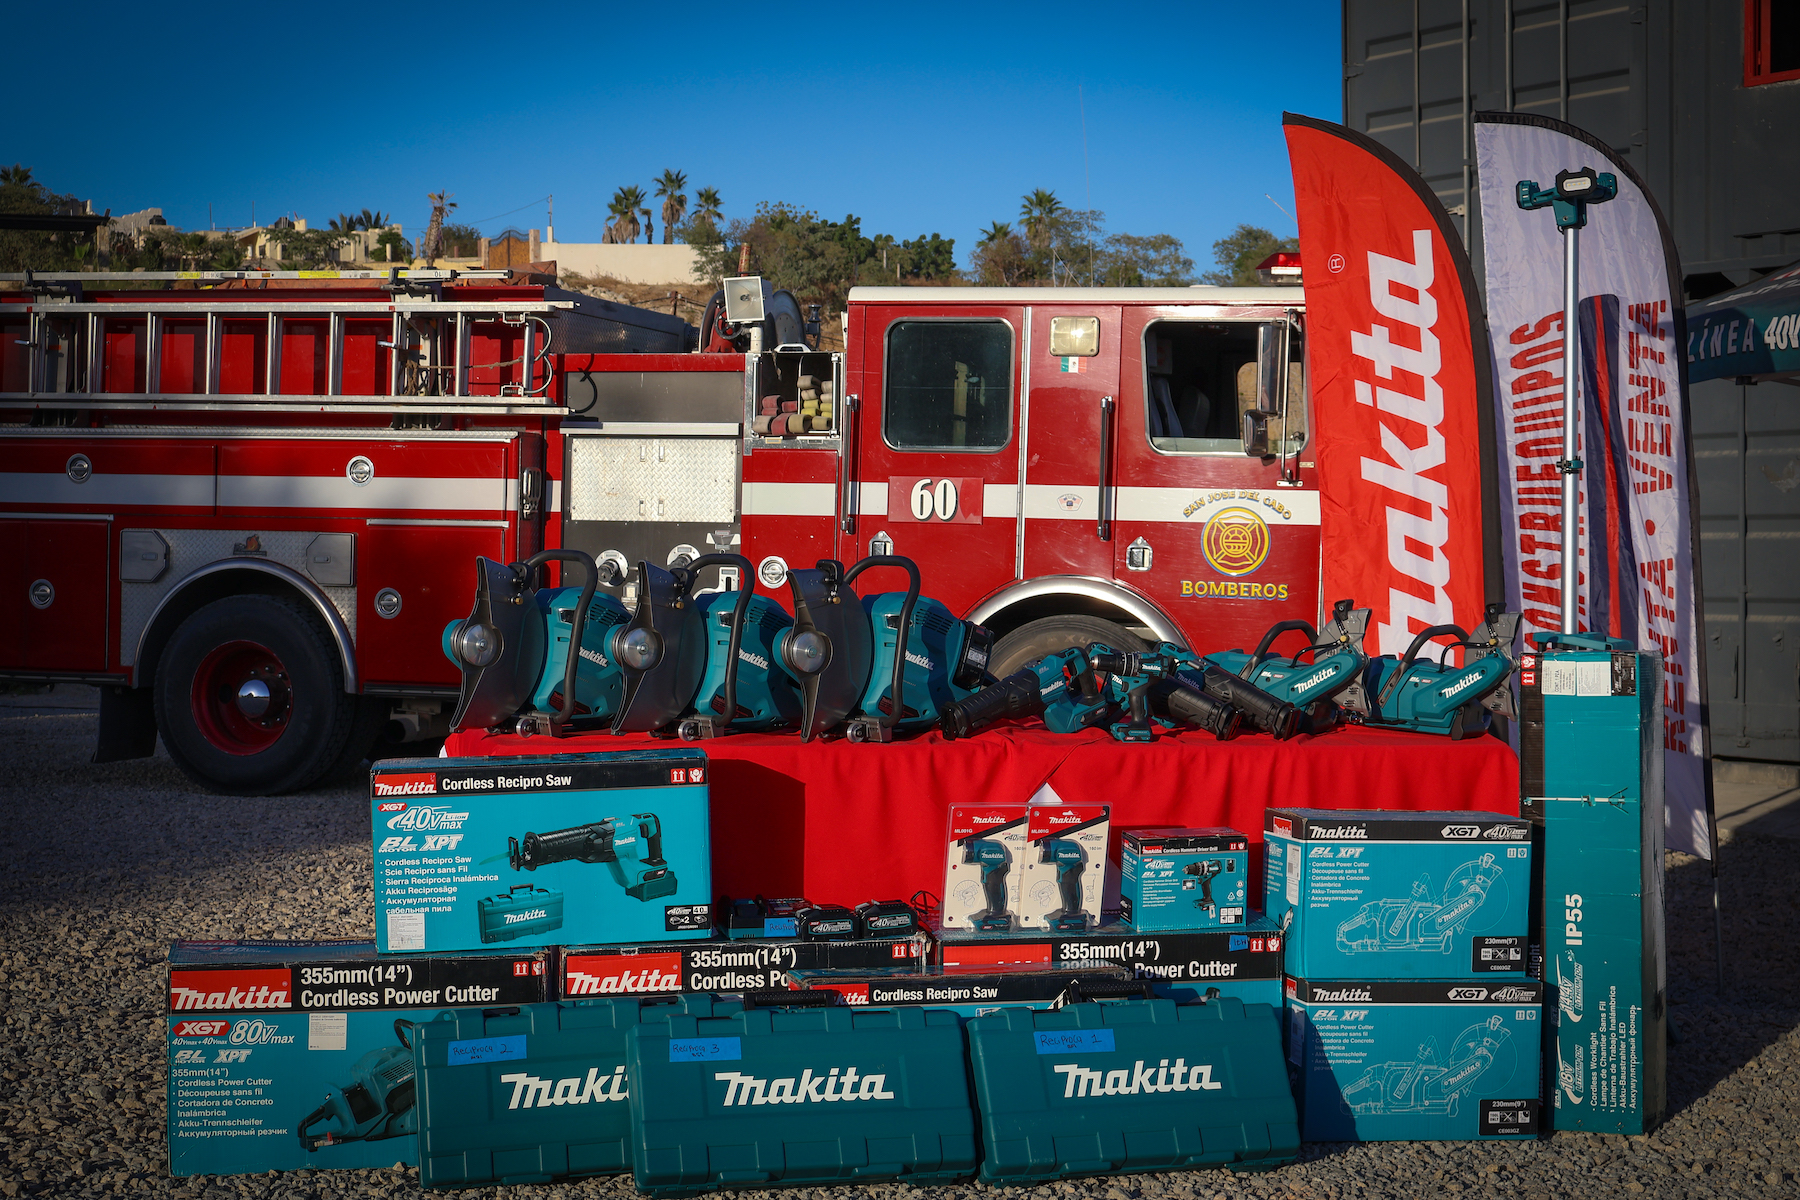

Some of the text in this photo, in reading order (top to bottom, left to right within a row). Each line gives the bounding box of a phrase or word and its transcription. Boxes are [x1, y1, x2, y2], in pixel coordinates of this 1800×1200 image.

[1688, 318, 1754, 362] LÍNEA
[910, 478, 958, 521] 60
[1183, 490, 1291, 519] SAN JOSE DEL CABO
[1180, 580, 1288, 601] BOMBEROS
[442, 774, 572, 791] Cordless Recipro Saw
[380, 803, 405, 811] XGT
[1446, 827, 1477, 836] XGT
[381, 836, 418, 849] BL
[419, 834, 464, 851] XPT
[1310, 847, 1335, 855] BL
[1336, 847, 1365, 858] XPT
[422, 858, 453, 866] Recipro
[453, 874, 499, 883] Inalámbrica
[408, 885, 458, 895] Reciprosäge
[386, 896, 456, 906] Аккумуляторная
[386, 905, 452, 914] сабельная пила
[1565, 893, 1583, 946] IP55
[1134, 960, 1238, 979] Power Cutter
[690, 972, 766, 991] Cordless
[301, 985, 499, 1008] Cordless Power Cutter
[872, 987, 998, 1002] Cordless Recipro Saw
[1453, 989, 1484, 998] XGT
[1314, 1010, 1338, 1018] BL
[1340, 1010, 1369, 1021] XPT
[1599, 1012, 1607, 1032] Sans
[179, 1021, 226, 1036] XGT
[271, 1033, 295, 1044] max
[1091, 1034, 1102, 1043] 1
[500, 1044, 513, 1053] 2
[710, 1044, 720, 1053] 3
[1599, 1033, 1607, 1068] Chantier
[1608, 985, 1618, 1108] Linterna de Trabajo Inalámbrica
[174, 1049, 207, 1060] BL
[213, 1049, 252, 1064] XPT
[1589, 1032, 1599, 1107] Cordless Worklight
[1599, 1068, 1607, 1078] de
[1618, 1041, 1627, 1108] Akku-Baustrahler
[1629, 1037, 1638, 1109] Аккумуляторный
[178, 1078, 272, 1087] Cordless Power Cutter
[178, 1088, 240, 1098] Découpeuse
[254, 1088, 263, 1096] fil
[1599, 1079, 1608, 1107] Lampe
[178, 1098, 274, 1107] Cortadora de Concreto
[177, 1109, 227, 1117] Inalámbrica
[178, 1118, 263, 1127] Akku-Trennschleifer
[178, 1128, 288, 1138] Аккумуляторный резчик
